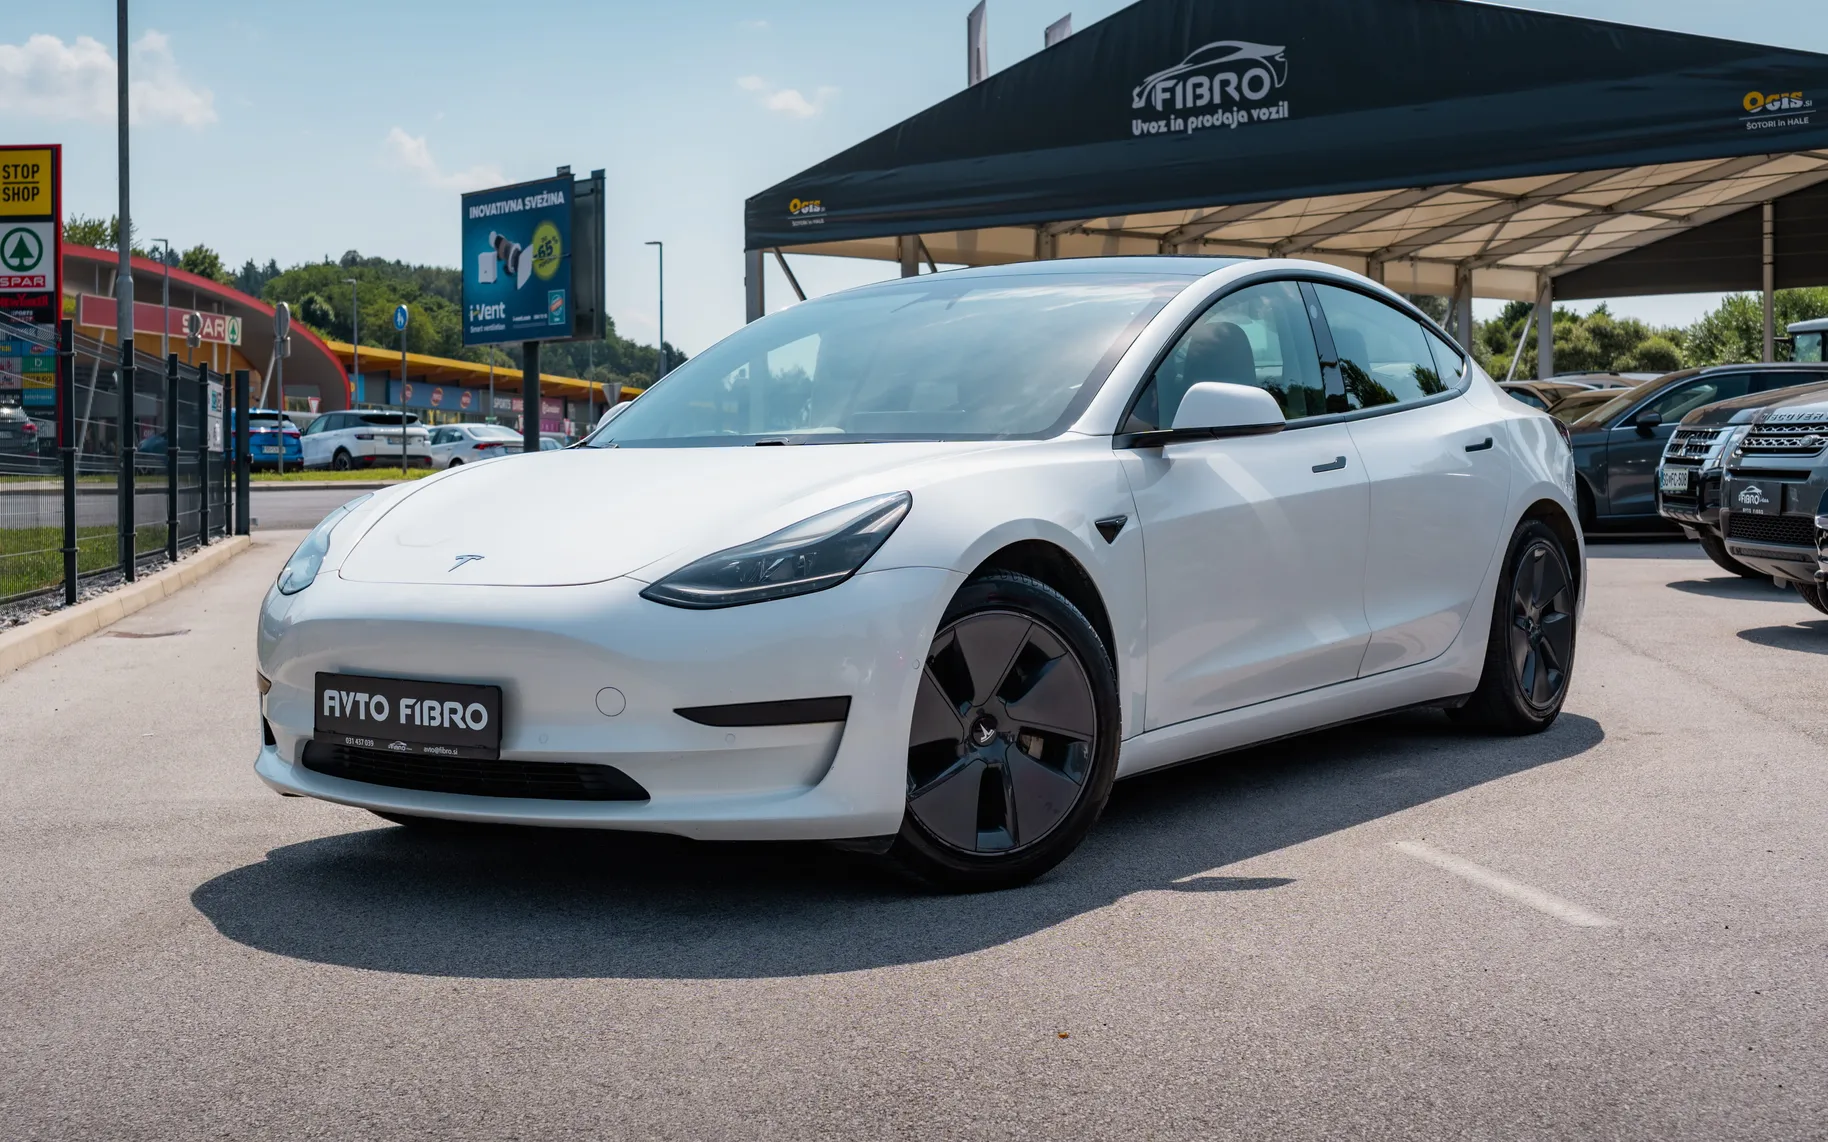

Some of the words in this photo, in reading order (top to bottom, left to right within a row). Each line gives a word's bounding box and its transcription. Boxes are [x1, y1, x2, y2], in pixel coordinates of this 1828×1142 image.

[1154, 67, 1271, 111] FIBRO
[1132, 119, 1167, 135] Uvoz
[1170, 114, 1184, 131] in
[1187, 106, 1248, 134] prodaja
[1251, 100, 1289, 121] vozil
[1777, 119, 1786, 127] in
[1787, 117, 1809, 126] HALE
[2, 164, 40, 179] STOP
[2, 186, 40, 202] SHOP
[469, 198, 524, 219] INOVATIVNA
[524, 190, 565, 210] SVEŽINA
[0, 276, 45, 287] SPAR
[182, 313, 225, 338] SAR
[1762, 412, 1828, 421] DISCOVER
[323, 689, 389, 722] AVTO
[400, 698, 488, 731] FIBRO
[345, 736, 354, 745] 031
[355, 738, 364, 746] 437
